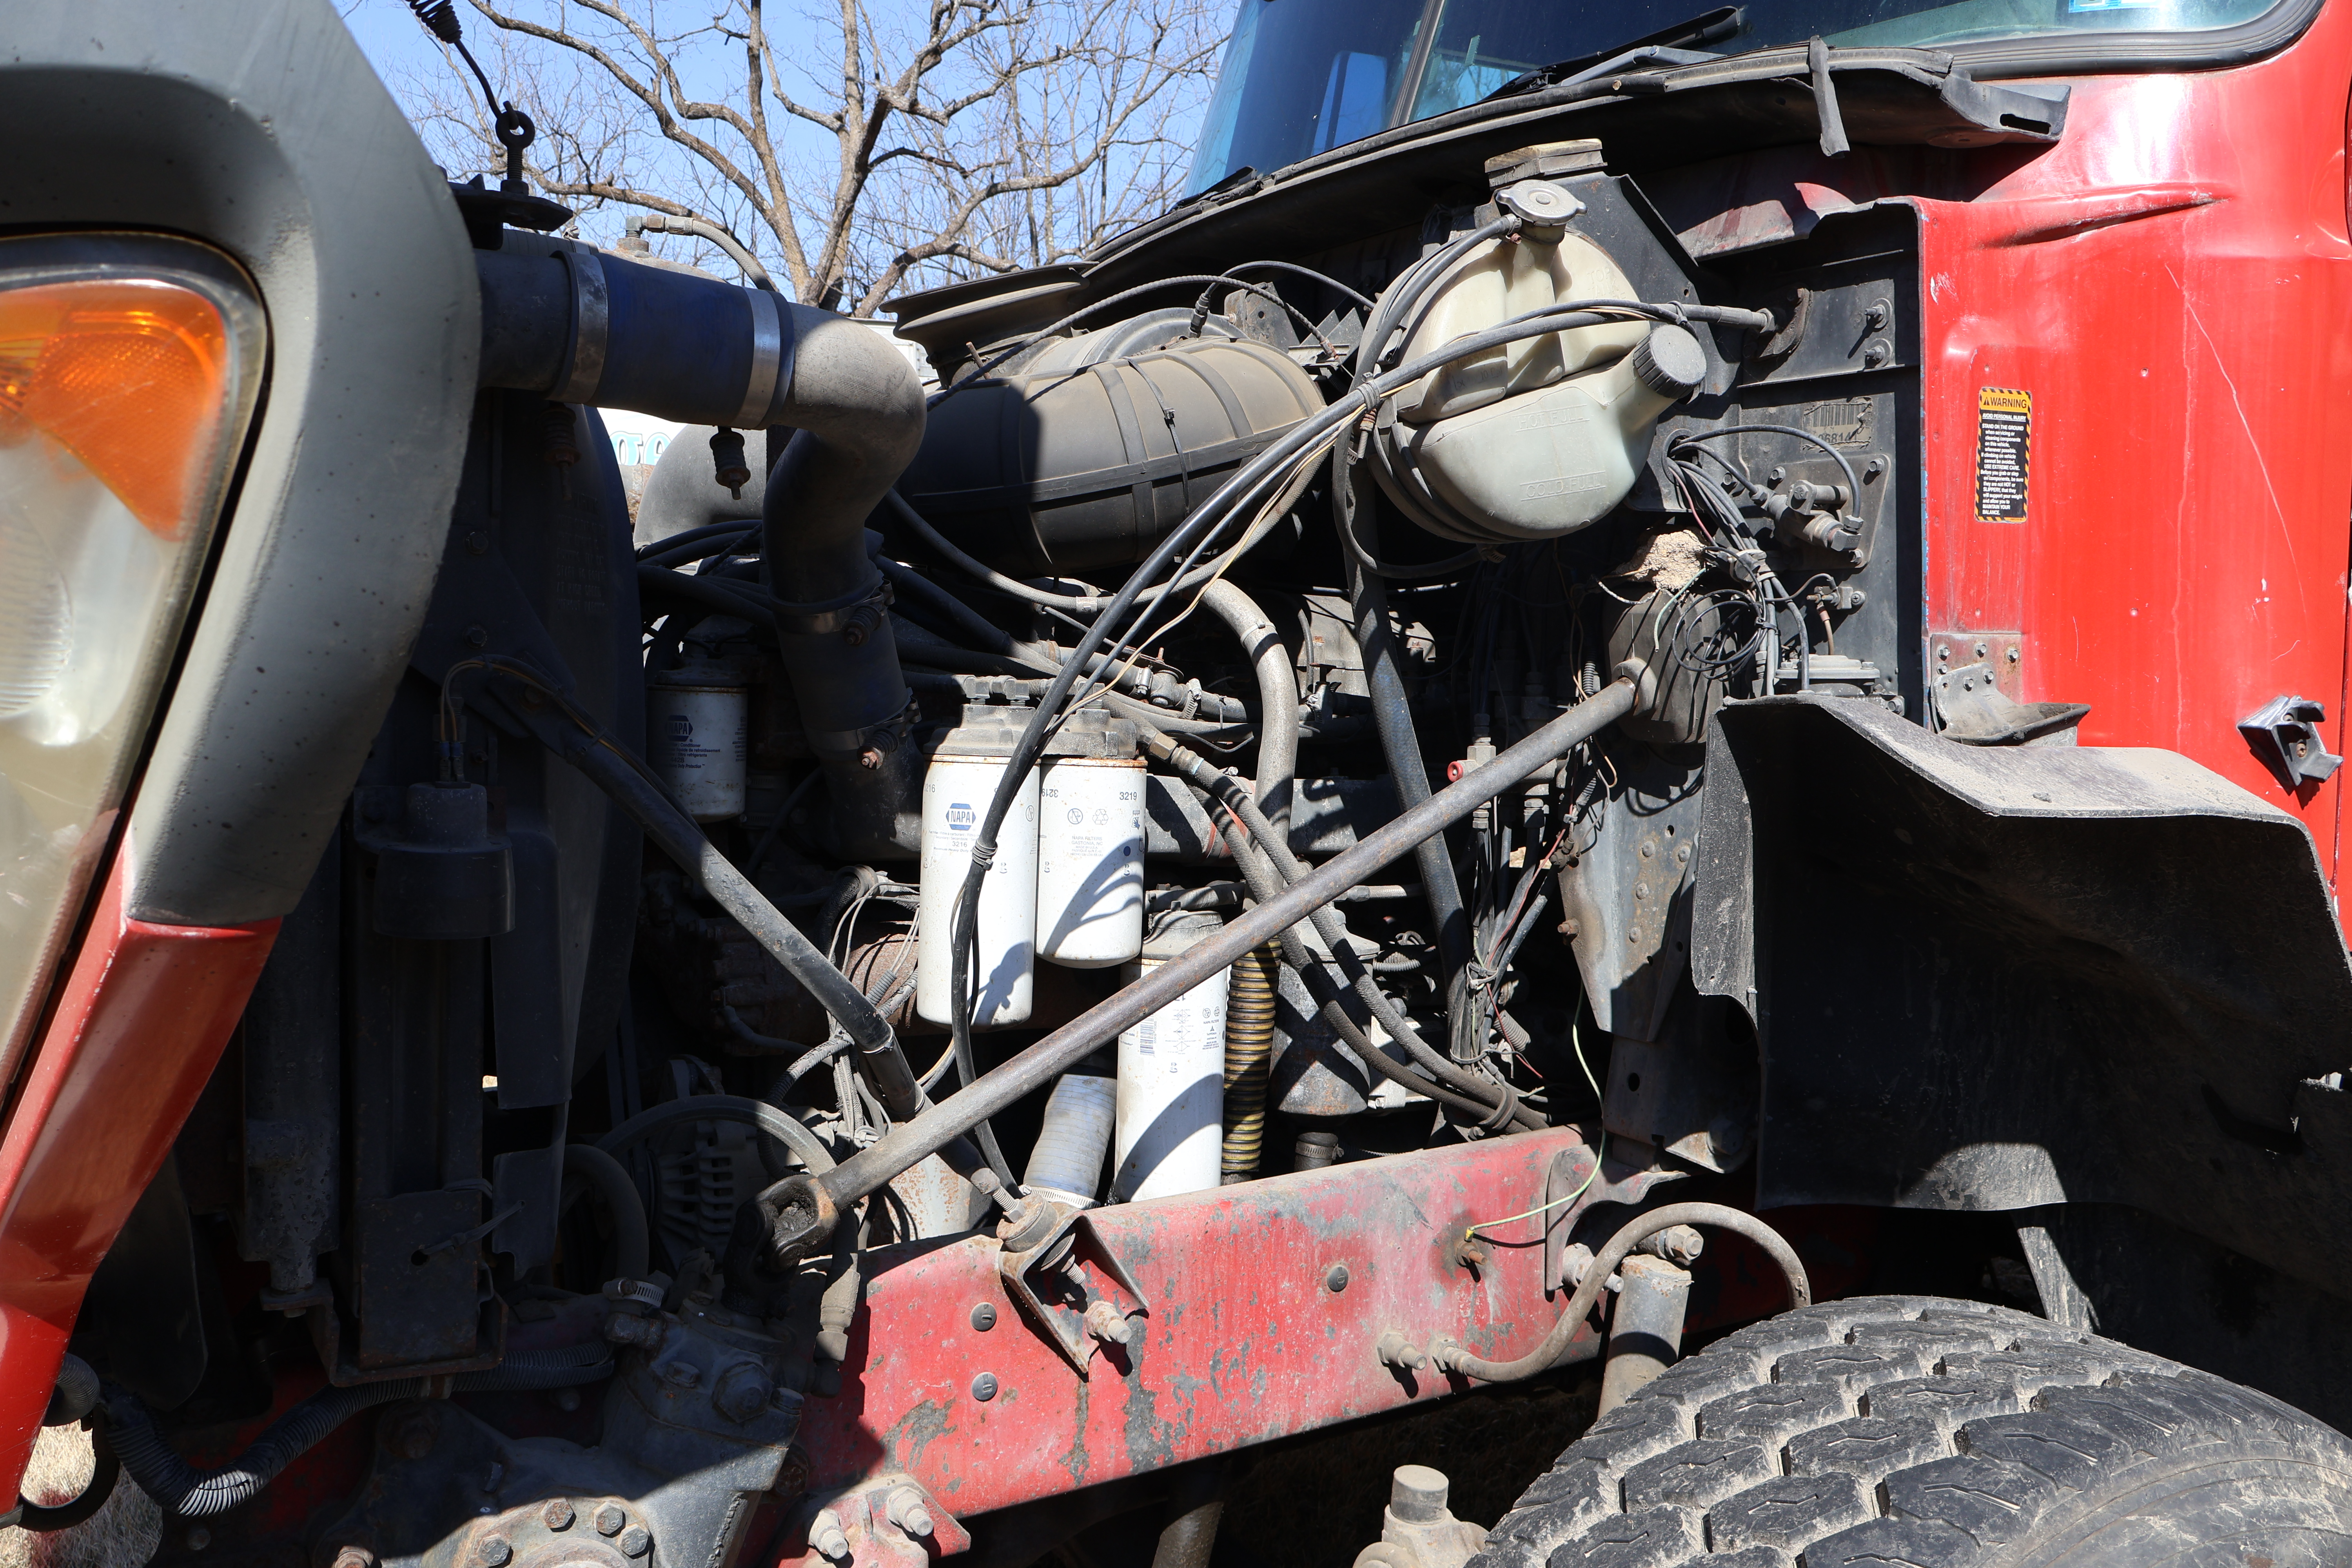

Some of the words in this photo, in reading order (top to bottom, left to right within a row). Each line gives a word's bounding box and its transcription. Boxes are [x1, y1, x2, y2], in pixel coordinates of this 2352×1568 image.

[1990, 397, 2027, 408] WARNING
[1518, 412, 1545, 430] HOT
[1550, 408, 1584, 425] FULL
[1526, 480, 1564, 497] COLD
[1569, 474, 1601, 491] FULL
[668, 722, 688, 735] NAPA
[1042, 788, 1058, 798] 3219
[1120, 792, 1137, 801] 3219
[950, 810, 971, 823] NAPA
